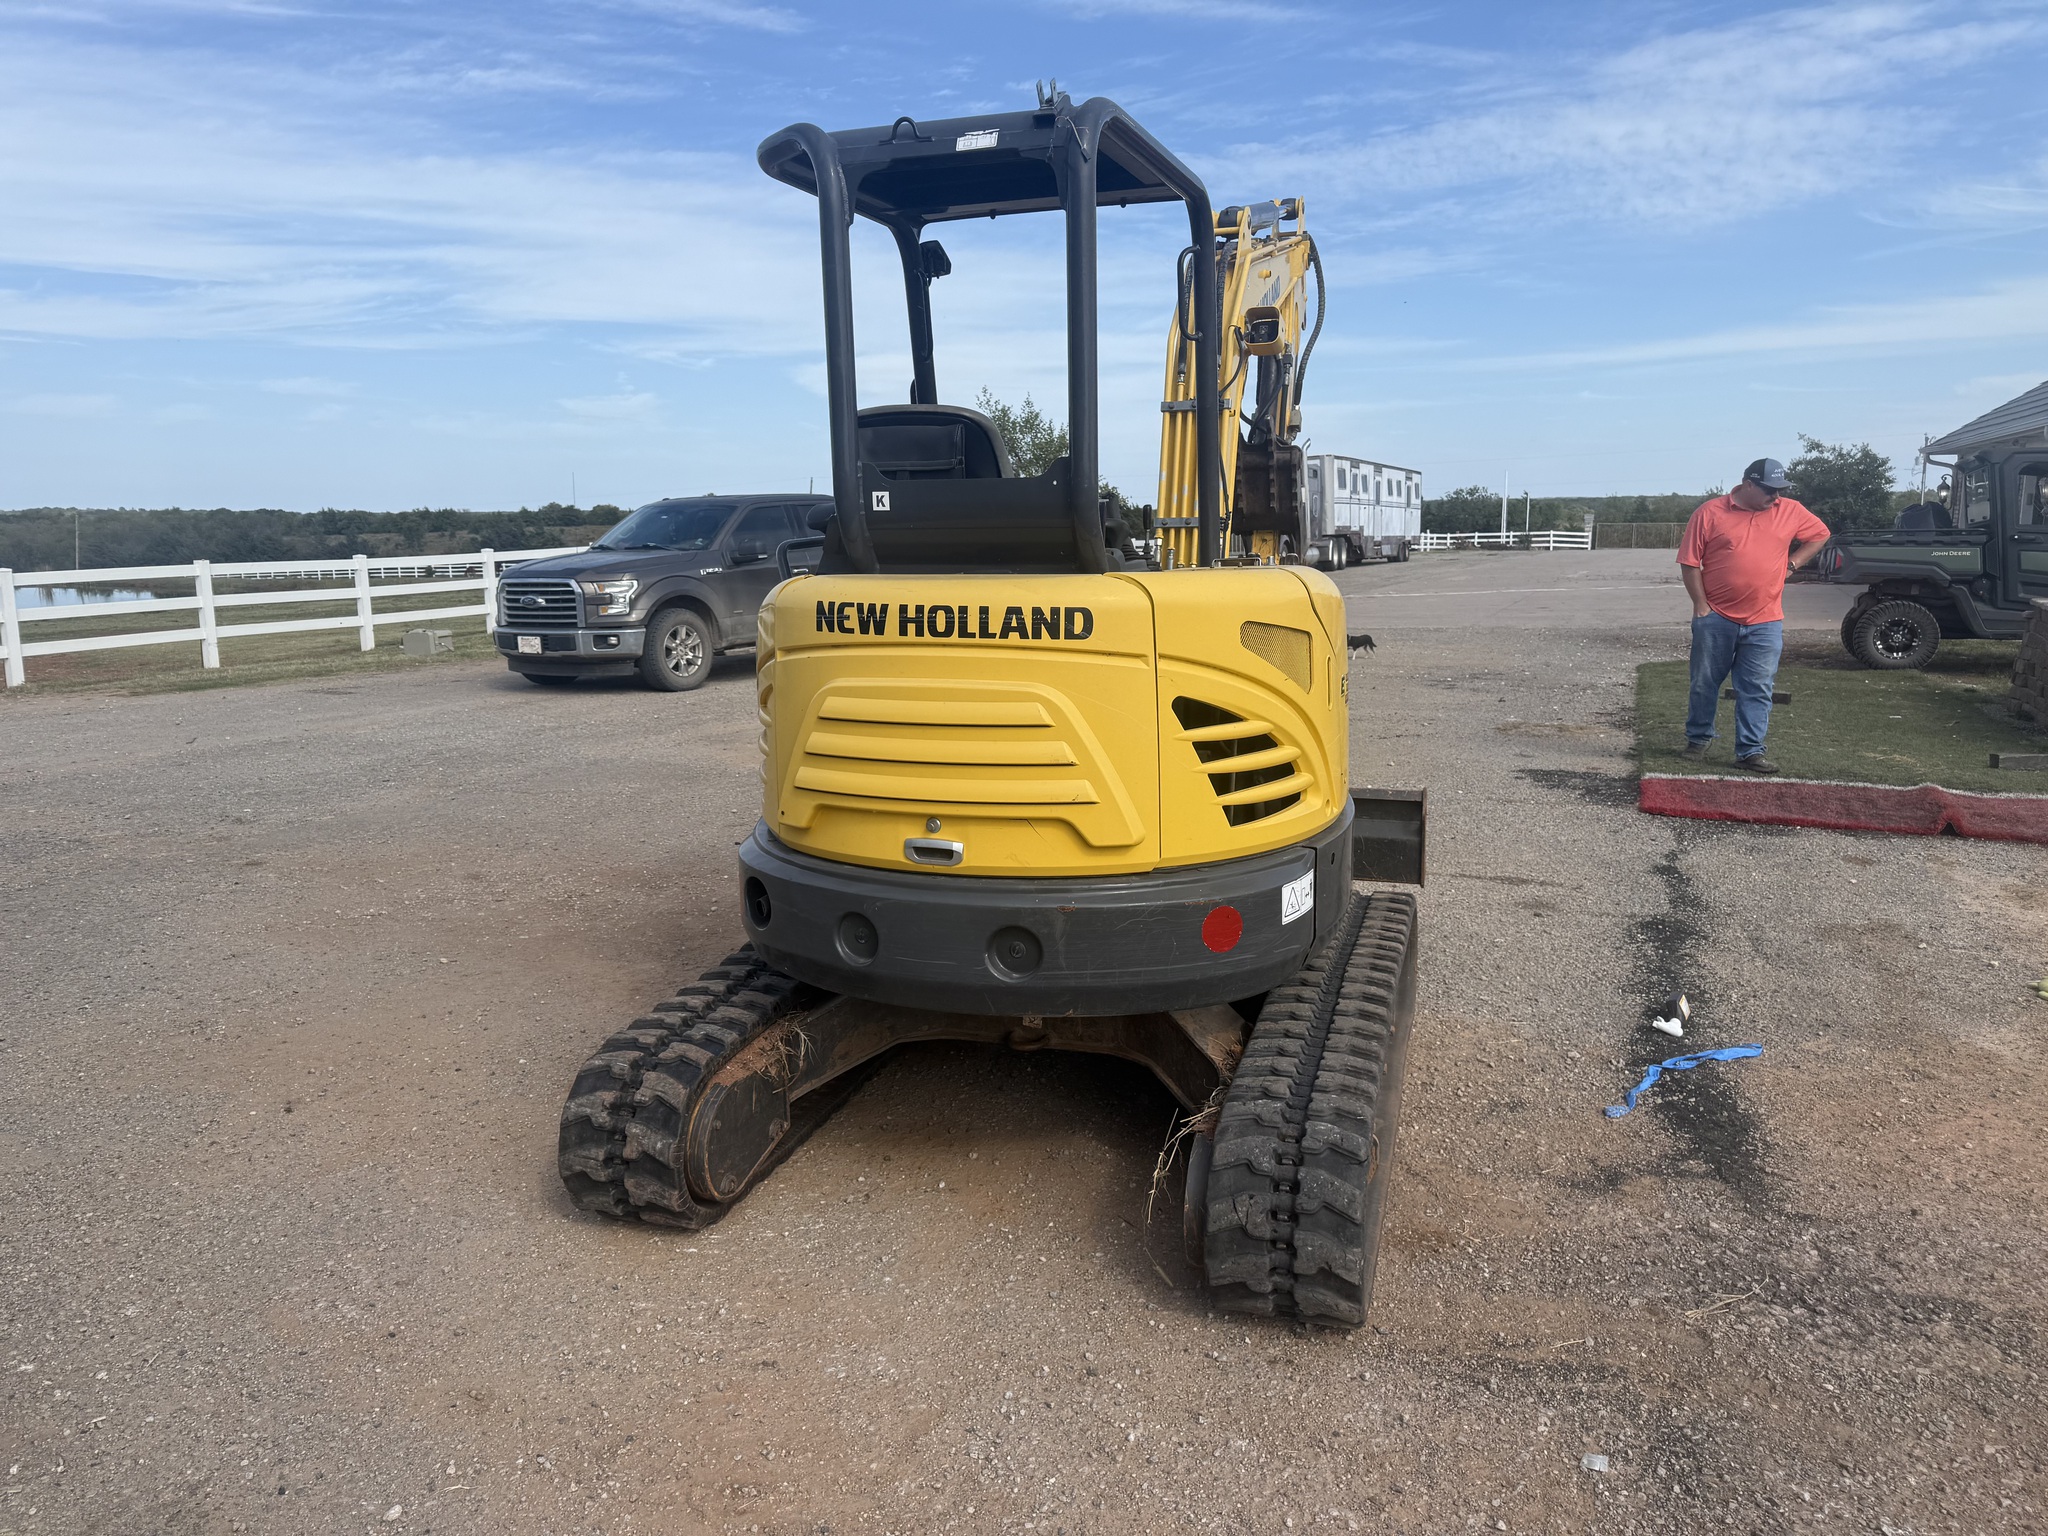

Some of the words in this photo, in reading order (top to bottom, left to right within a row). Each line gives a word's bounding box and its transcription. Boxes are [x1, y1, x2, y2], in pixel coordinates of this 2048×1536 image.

[876, 494, 886, 508] K
[815, 600, 889, 636] NEW
[898, 603, 1094, 640] HOLLAND
